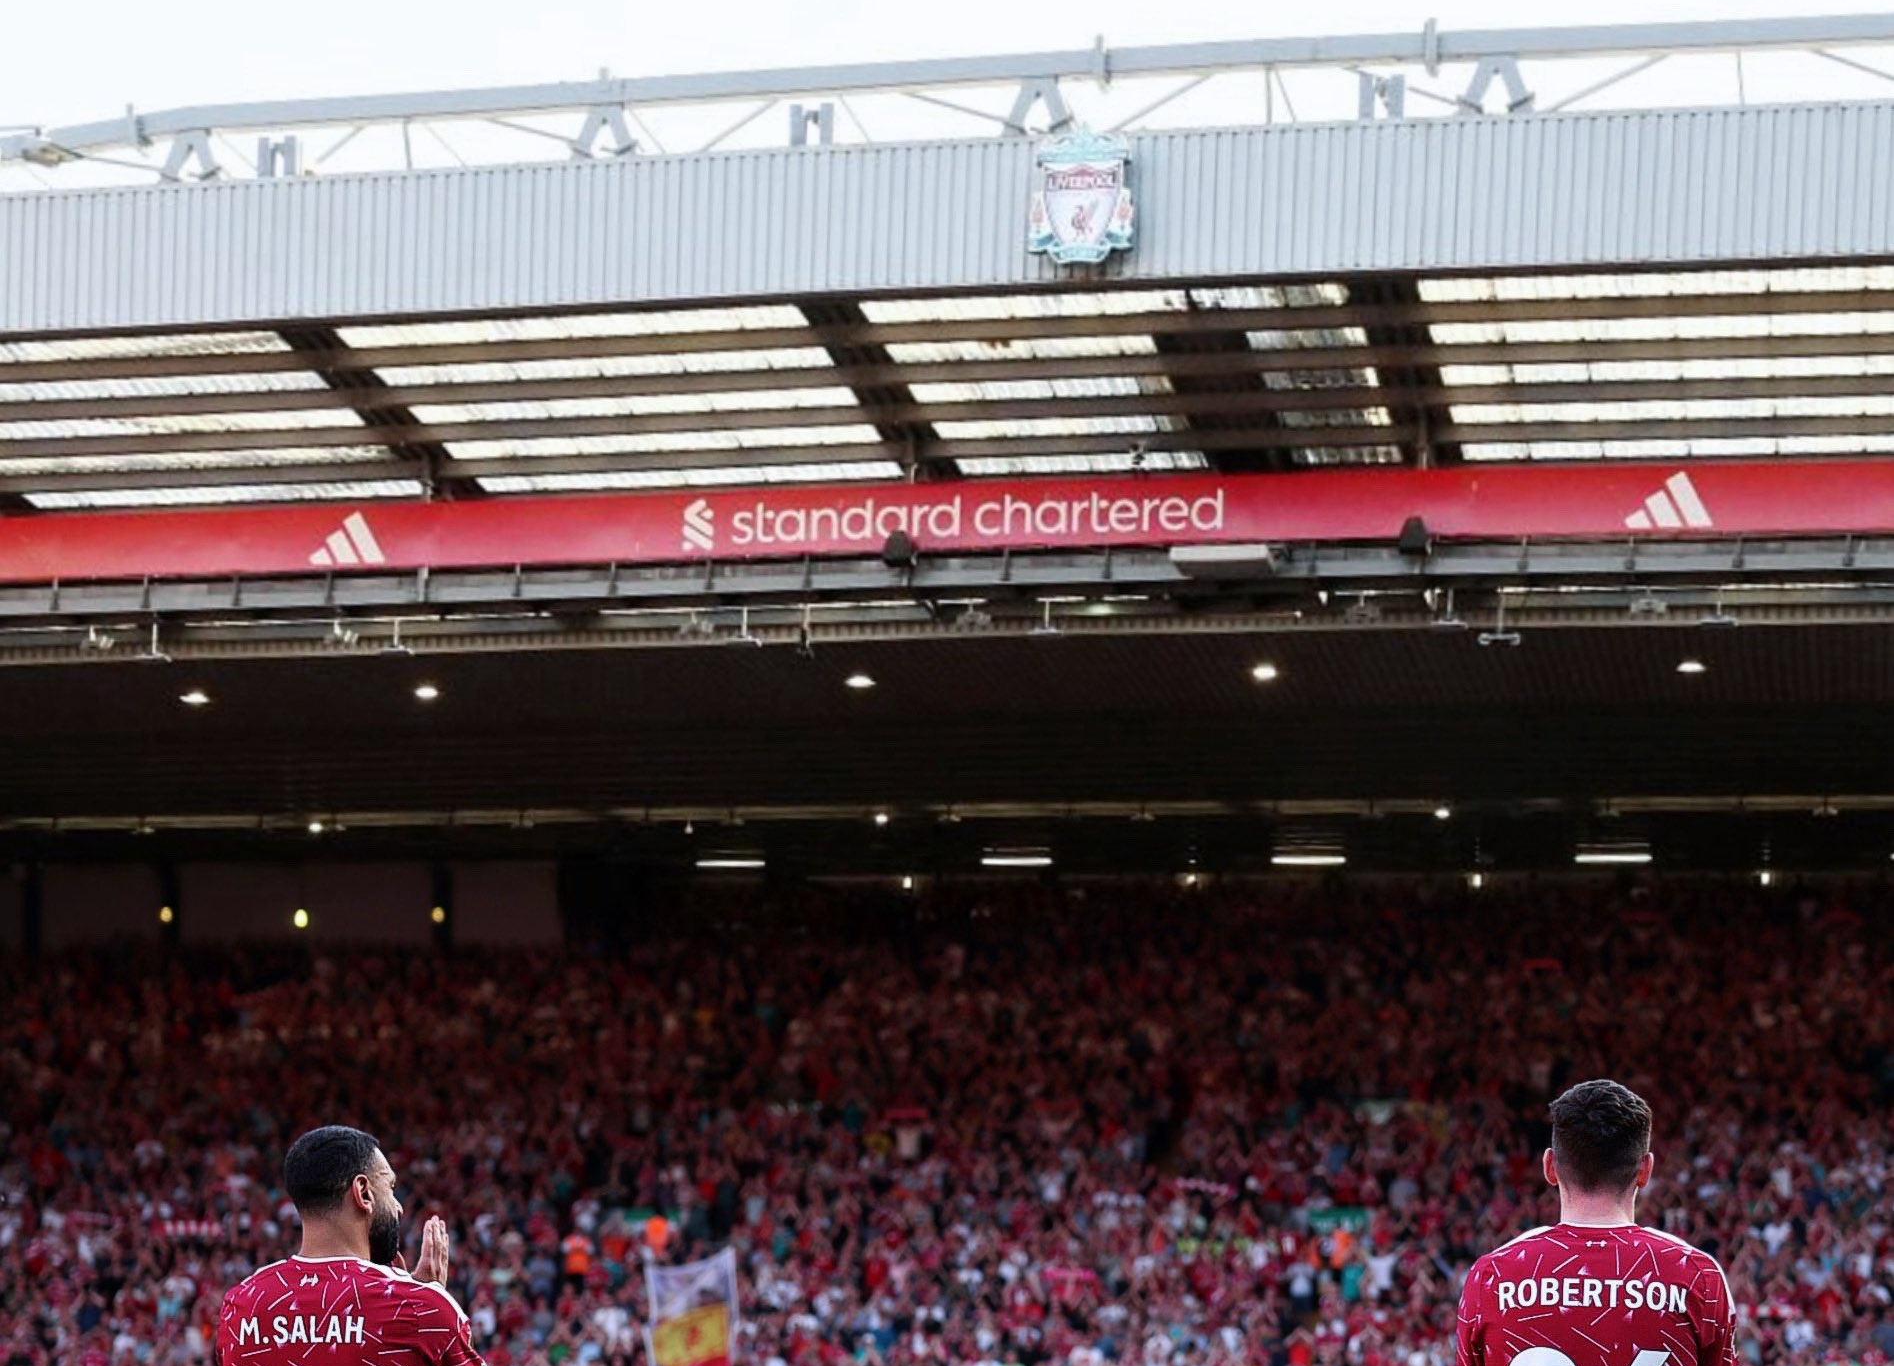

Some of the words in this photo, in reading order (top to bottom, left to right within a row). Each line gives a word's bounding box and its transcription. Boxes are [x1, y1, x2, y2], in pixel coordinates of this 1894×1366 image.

[731, 496, 961, 545] standard
[974, 489, 1223, 535] chartered
[1498, 1277, 1687, 1314] ROBERTSON
